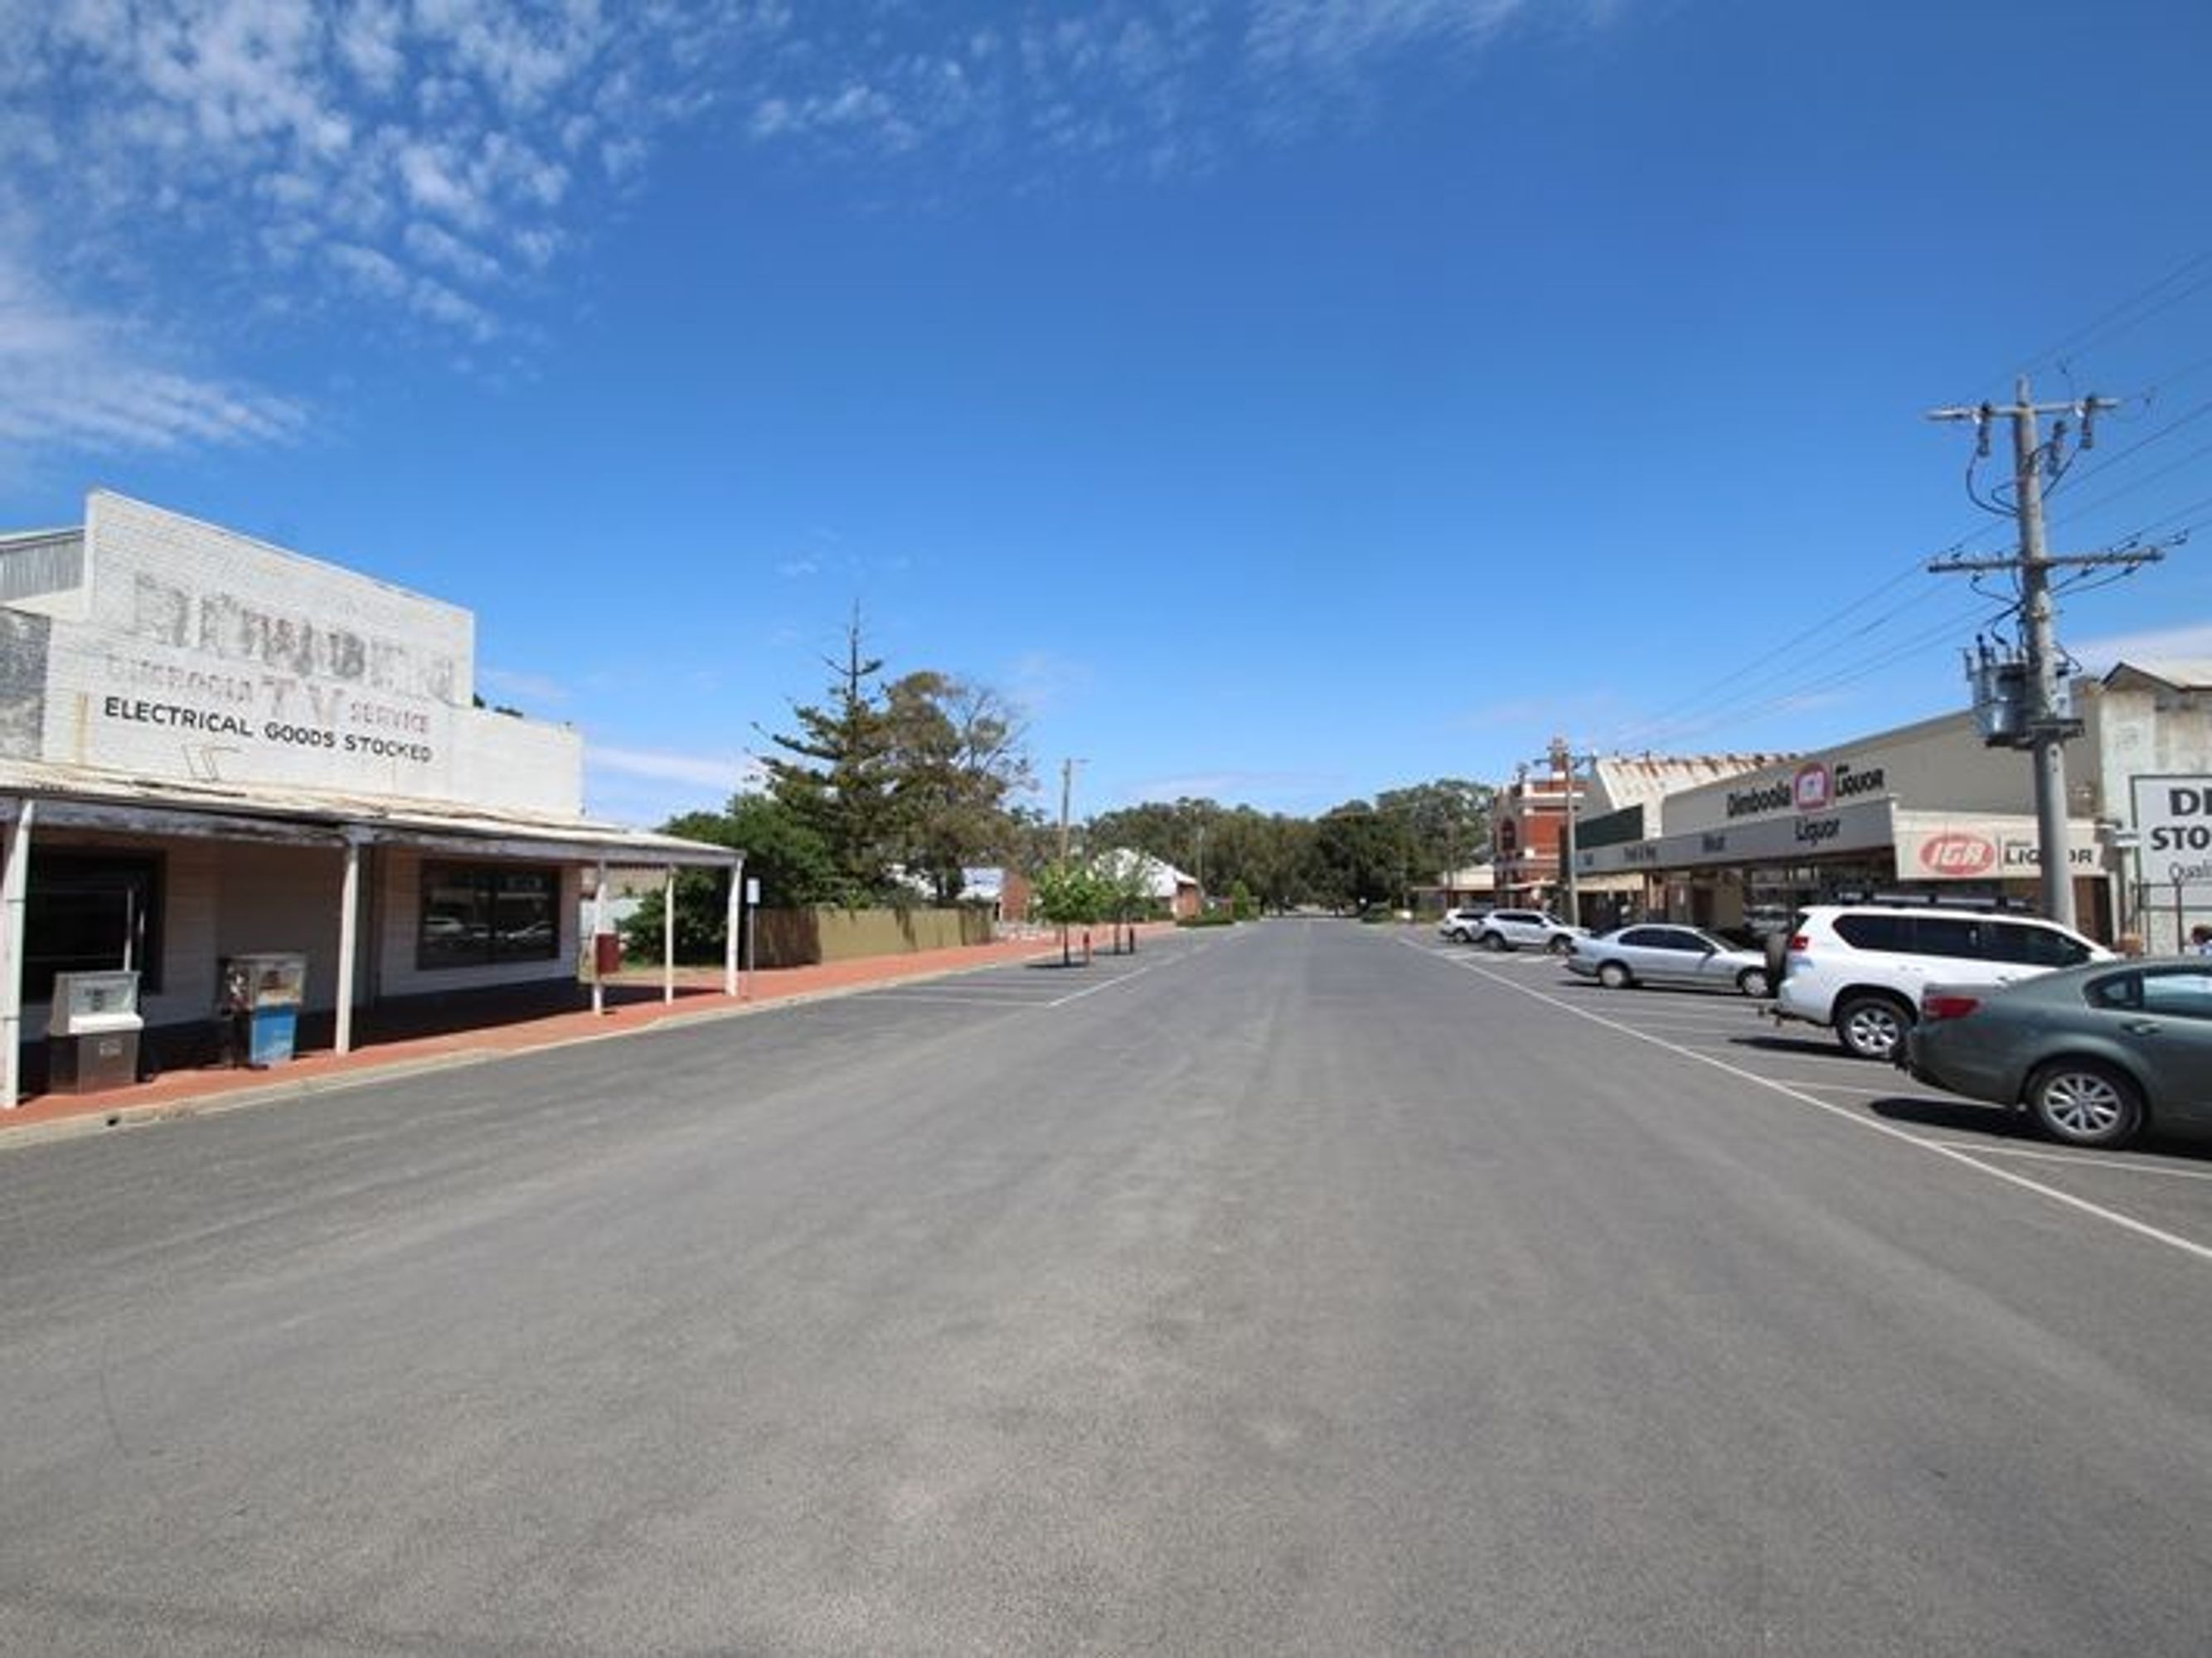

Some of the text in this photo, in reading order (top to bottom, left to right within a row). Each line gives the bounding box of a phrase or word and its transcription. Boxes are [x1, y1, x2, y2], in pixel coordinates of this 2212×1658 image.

[104, 696, 433, 764] ELECTRICAL GOODS STOCKED
[1726, 780, 1792, 818] Dimboola
[1794, 817, 1841, 846] Liquor
[1928, 841, 1986, 866] IGA
